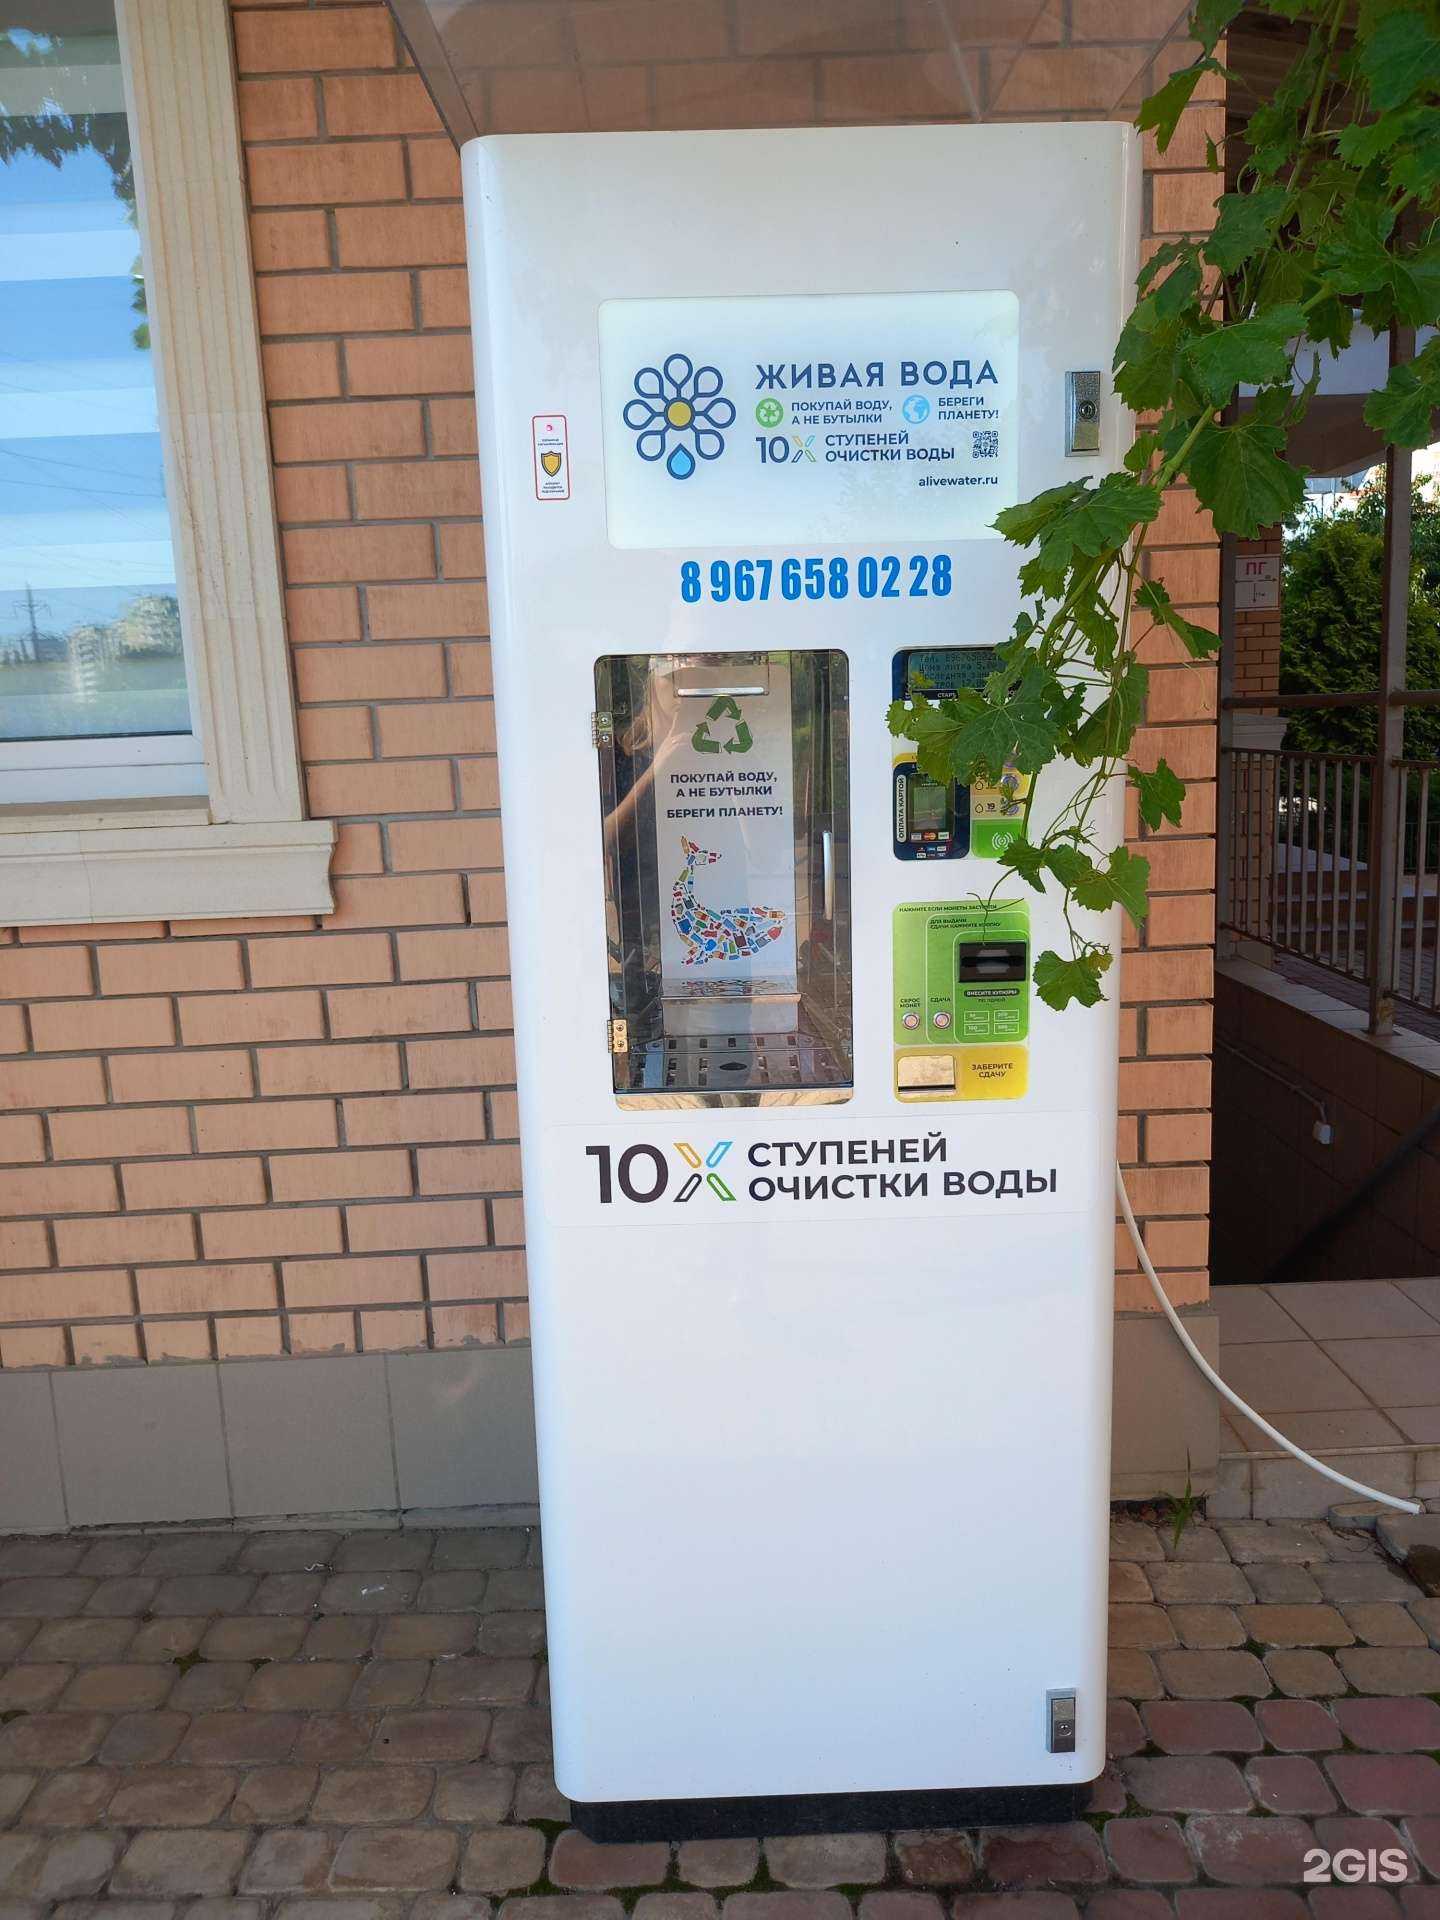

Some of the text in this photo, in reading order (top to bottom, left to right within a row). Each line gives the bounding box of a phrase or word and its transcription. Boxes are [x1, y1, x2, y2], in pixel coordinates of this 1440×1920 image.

[755, 359, 999, 390] ЖИВАЯ ВОДА
[791, 398, 893, 412] ПОКУПАЙ ВОДУ,
[937, 396, 985, 408] БЕРЕГИ
[791, 413, 883, 425] А НЕ БУТЫЛКИ
[937, 409, 999, 421] ПЛАНЕТУ!
[825, 430, 909, 447] СТУПЕНЕЙ
[825, 446, 956, 463] ОЧИСТКИ ВОДЫ
[918, 474, 999, 487] alivewater.ru
[1246, 561, 1267, 575] ПГ
[680, 553, 953, 603] 8 967 658 02 28
[670, 768, 778, 784] ПОКУПАЙ ВОДУ,
[676, 785, 773, 797] А НЕ БУТЫЛКИ
[666, 806, 783, 819] БЕРЕГИ ПЛАНЕТУ!
[971, 1063, 1014, 1071] ЗАБЕРИТЕ
[978, 1071, 1007, 1079] СДАЧУ
[747, 1131, 948, 1168] СТУПЕНЕЙ
[748, 1168, 1058, 1202] ОЧИСТКИ ВОДЫ
